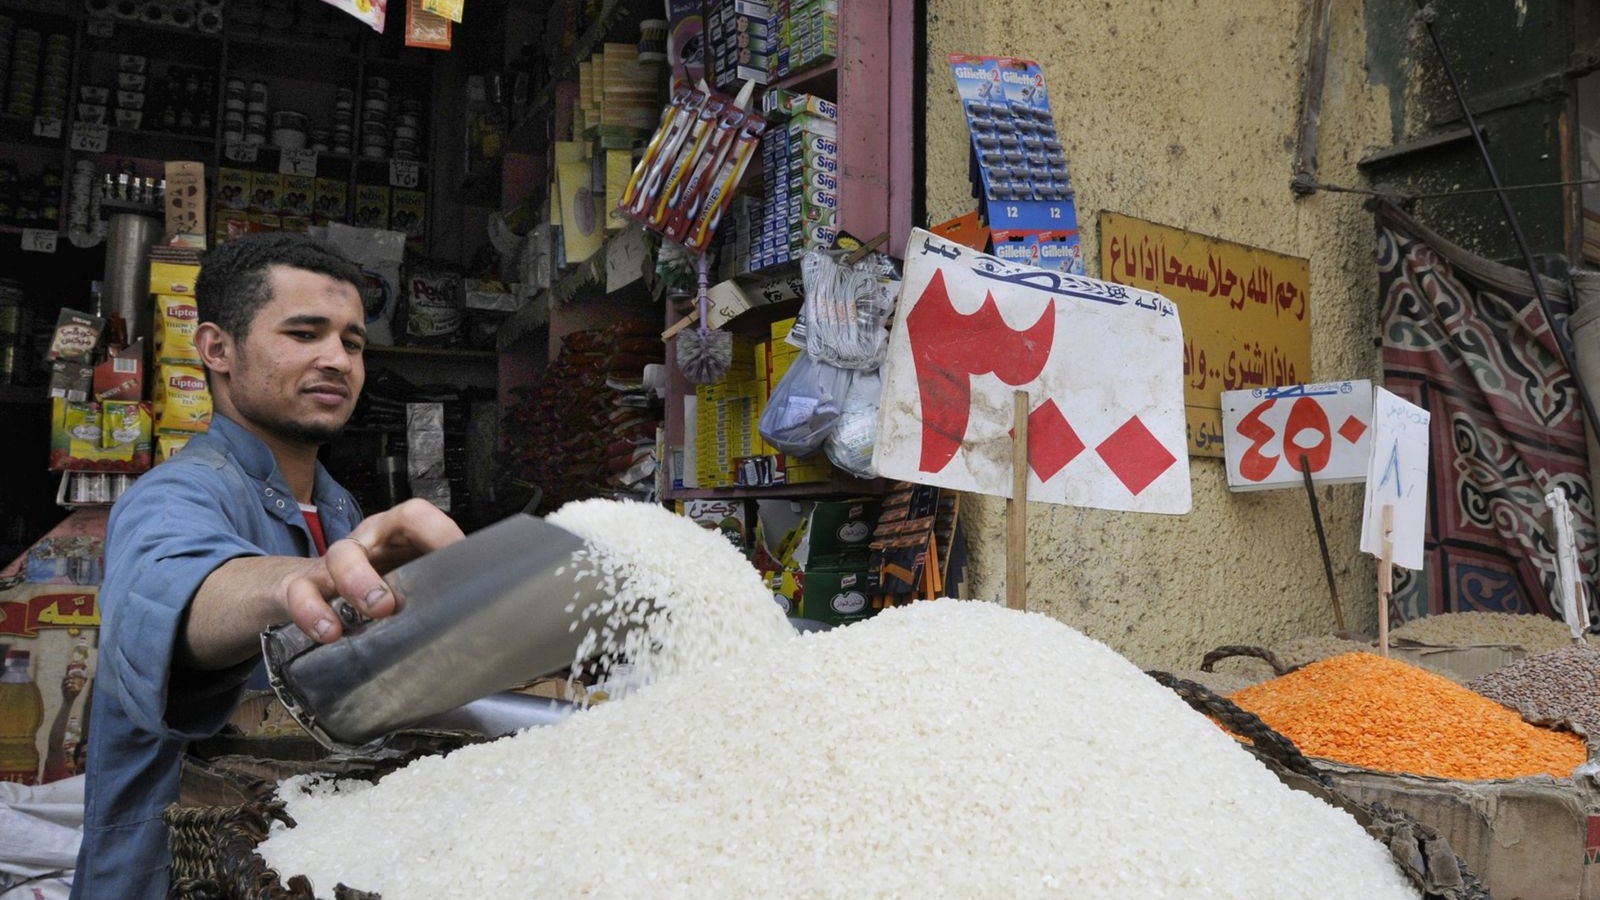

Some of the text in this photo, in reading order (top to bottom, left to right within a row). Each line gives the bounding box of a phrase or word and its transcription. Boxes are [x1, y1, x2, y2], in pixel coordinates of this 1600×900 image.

[955, 67, 992, 82] Gillette
[1002, 72, 1035, 85] Gillette
[819, 100, 837, 118] Sig
[1007, 206, 1019, 218] 12
[1050, 207, 1061, 219] 12
[997, 244, 1031, 258] Gillette
[1041, 244, 1073, 258] Gillette
[1247, 264, 1273, 305] الله
[1275, 281, 1305, 321] رحم
[171, 377, 204, 390] Lipton
[906, 267, 1177, 497] ٣٠٠
[1236, 396, 1368, 482] ٤٥٠
